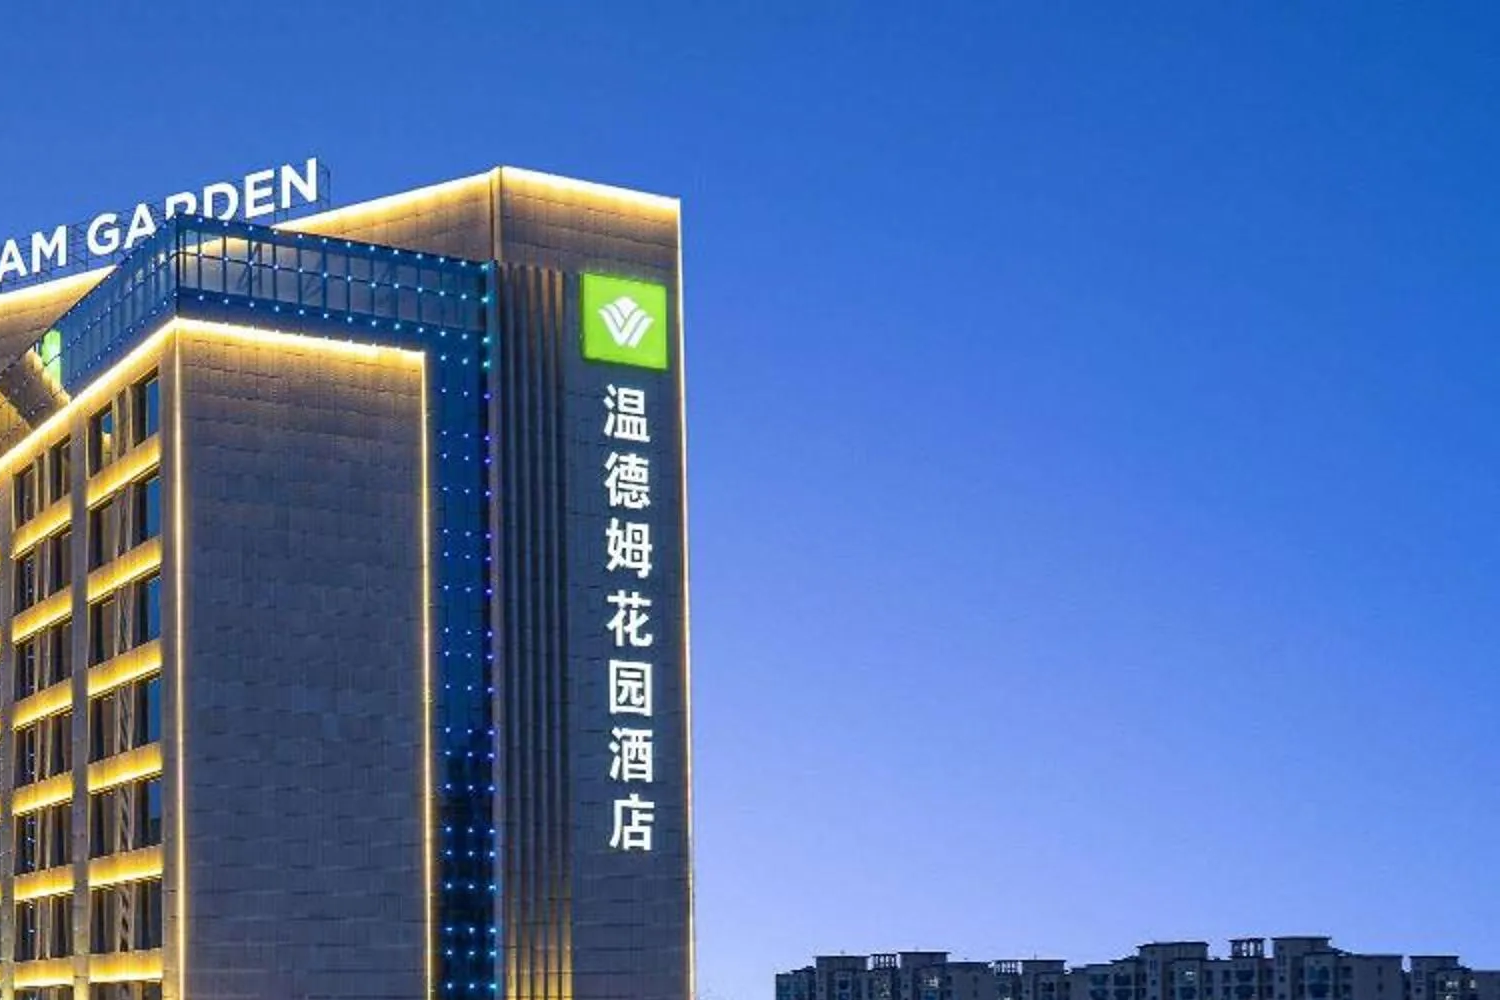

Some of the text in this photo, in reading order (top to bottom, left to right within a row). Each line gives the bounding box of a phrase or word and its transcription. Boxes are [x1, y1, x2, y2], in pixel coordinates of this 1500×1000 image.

[603, 384, 655, 851] 温德姆花园酒店
